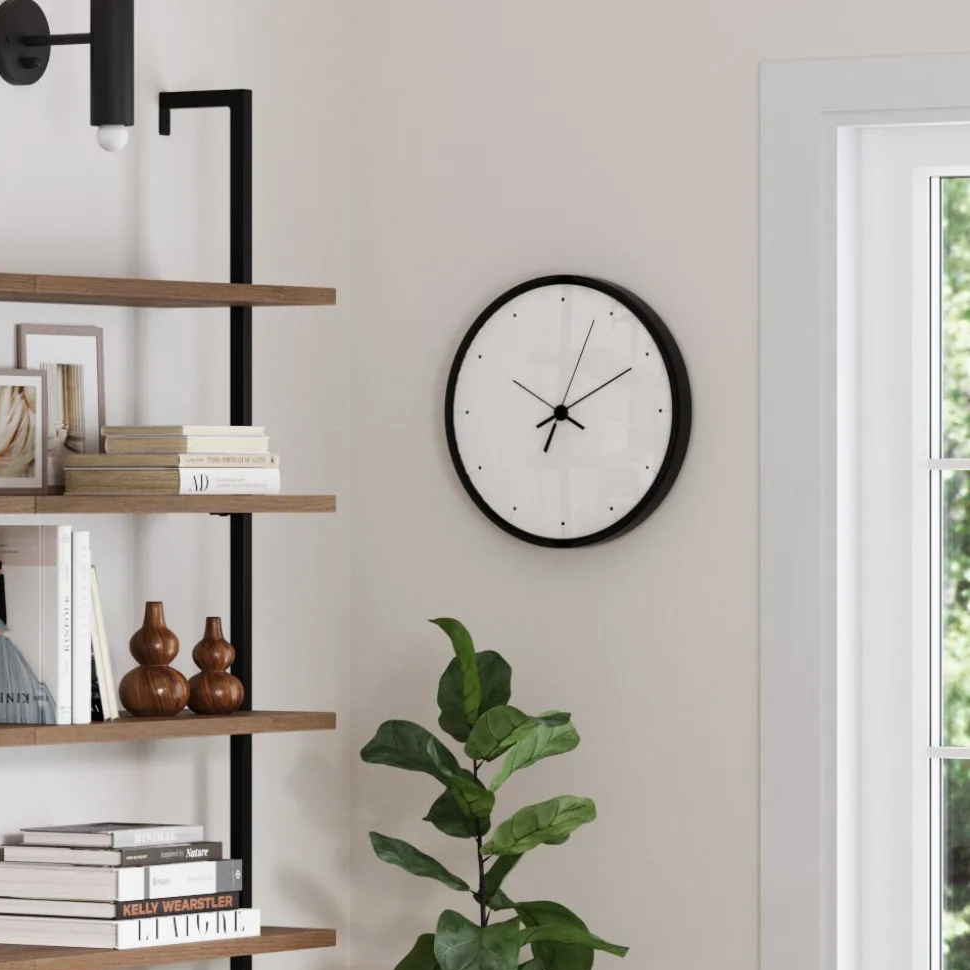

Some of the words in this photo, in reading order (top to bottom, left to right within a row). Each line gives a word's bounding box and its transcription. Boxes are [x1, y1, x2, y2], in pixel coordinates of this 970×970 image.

[185, 847, 209, 859] Nature
[122, 901, 160, 918] KELLY
[162, 895, 234, 914] WEARSTLER
